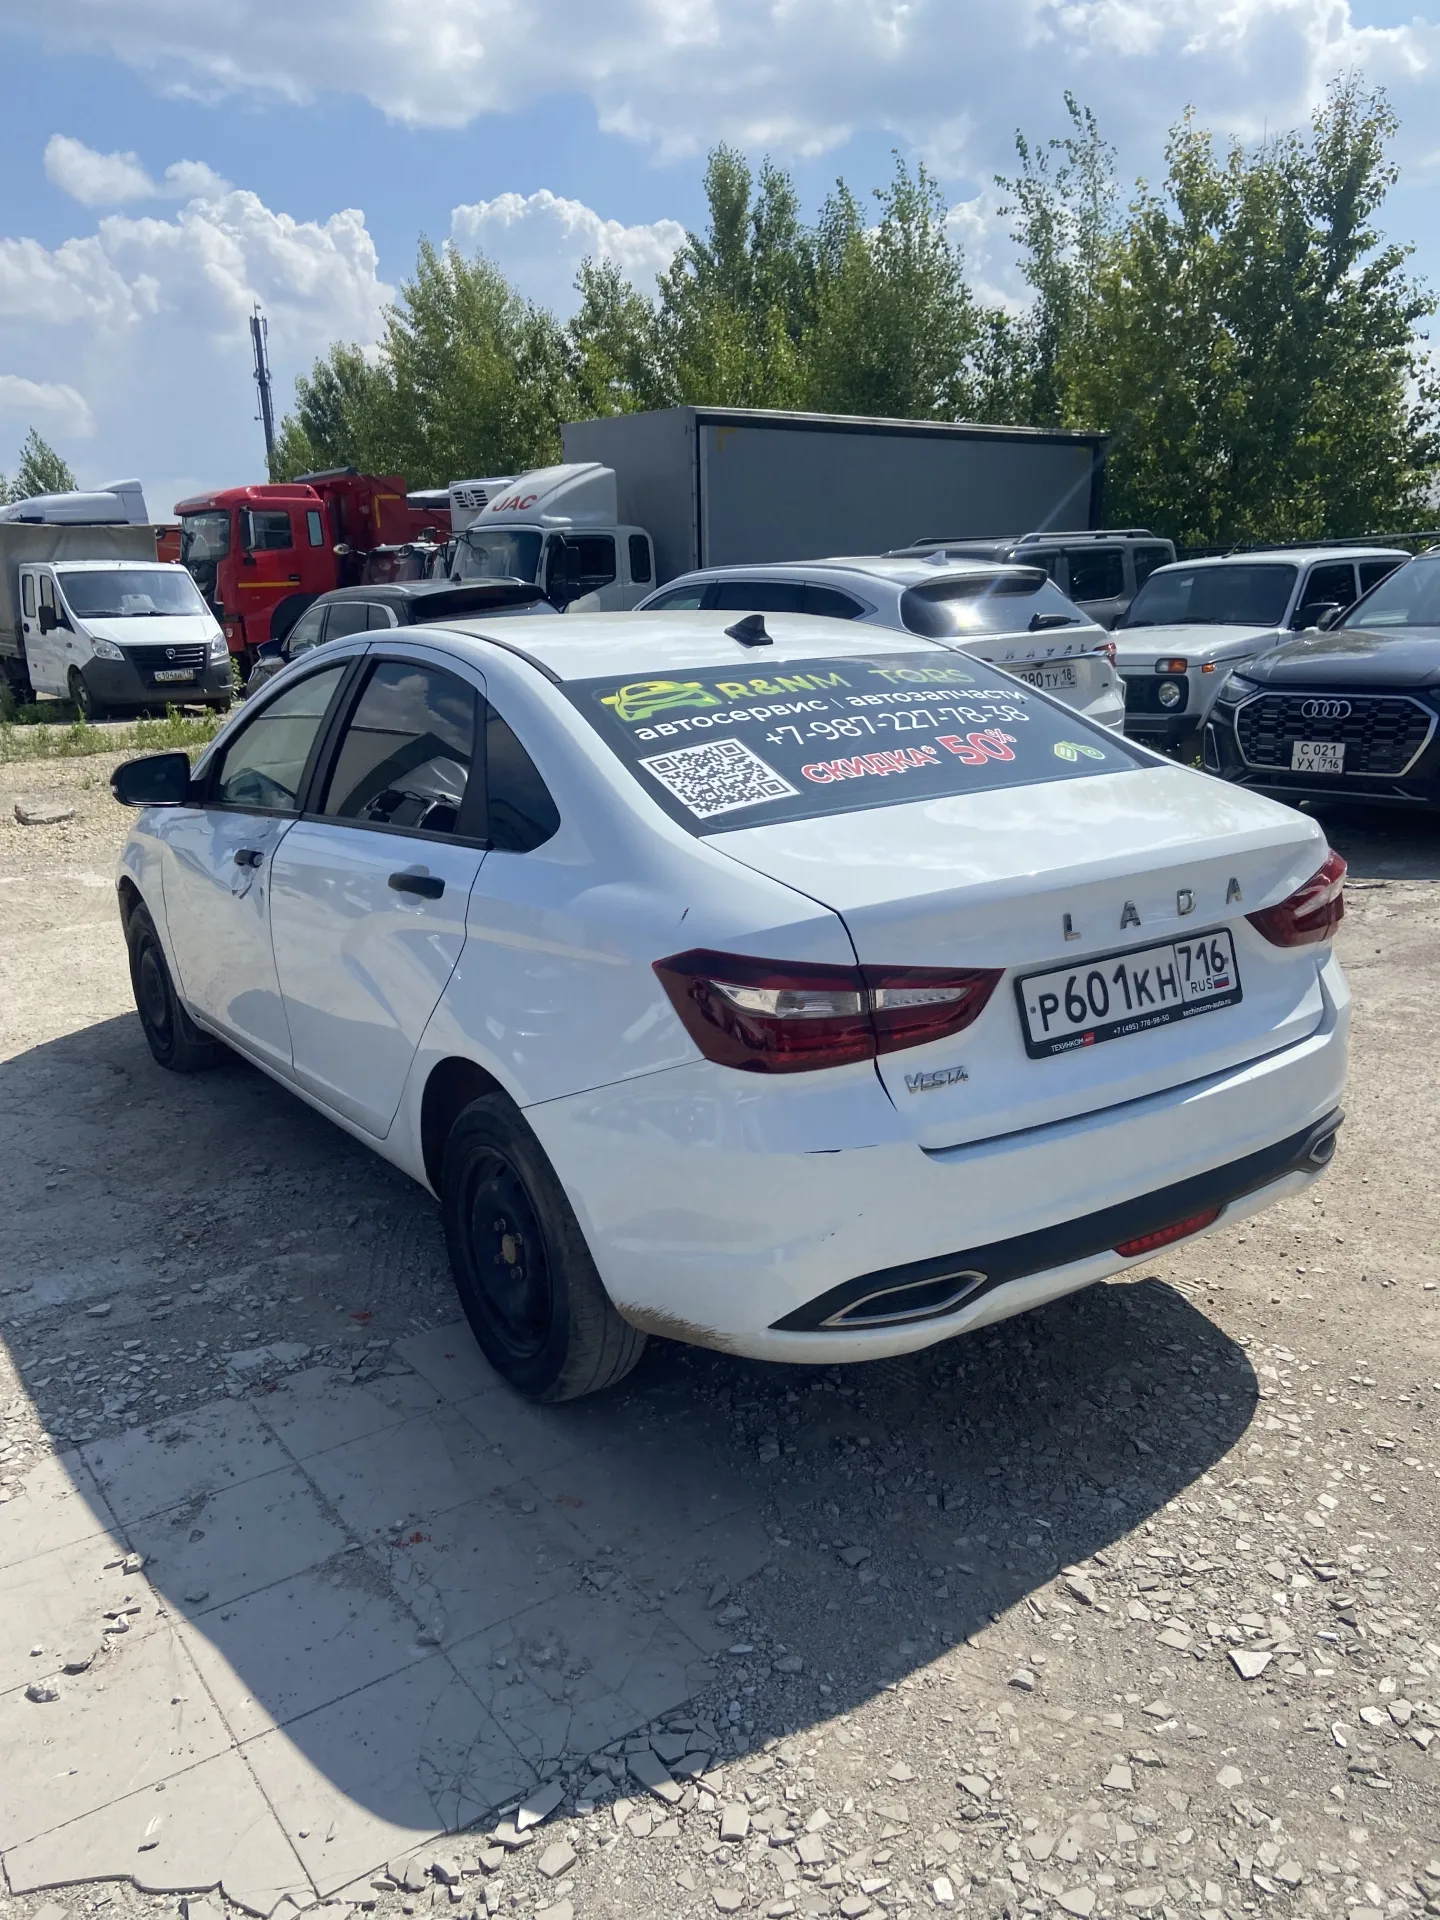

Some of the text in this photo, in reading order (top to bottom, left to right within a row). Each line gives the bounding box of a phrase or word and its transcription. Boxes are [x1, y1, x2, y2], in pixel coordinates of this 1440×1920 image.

[492, 495, 538, 512] JAC
[634, 689, 1029, 740] автосервис автозапчасти
[765, 704, 1030, 745] +7-987-227-78-38
[935, 728, 1018, 766] 50%
[1321, 759, 1339, 770] 716
[1062, 876, 1243, 942] LADA
[1038, 938, 1226, 1032] Р601КН 716
[1190, 977, 1214, 994] RUS
[1182, 998, 1232, 1017] techincom-auto.ru
[1122, 1022, 1139, 1034] (495)
[1050, 1037, 1085, 1053] ТЕХИНКОМ
[904, 1065, 969, 1094] VESTA
